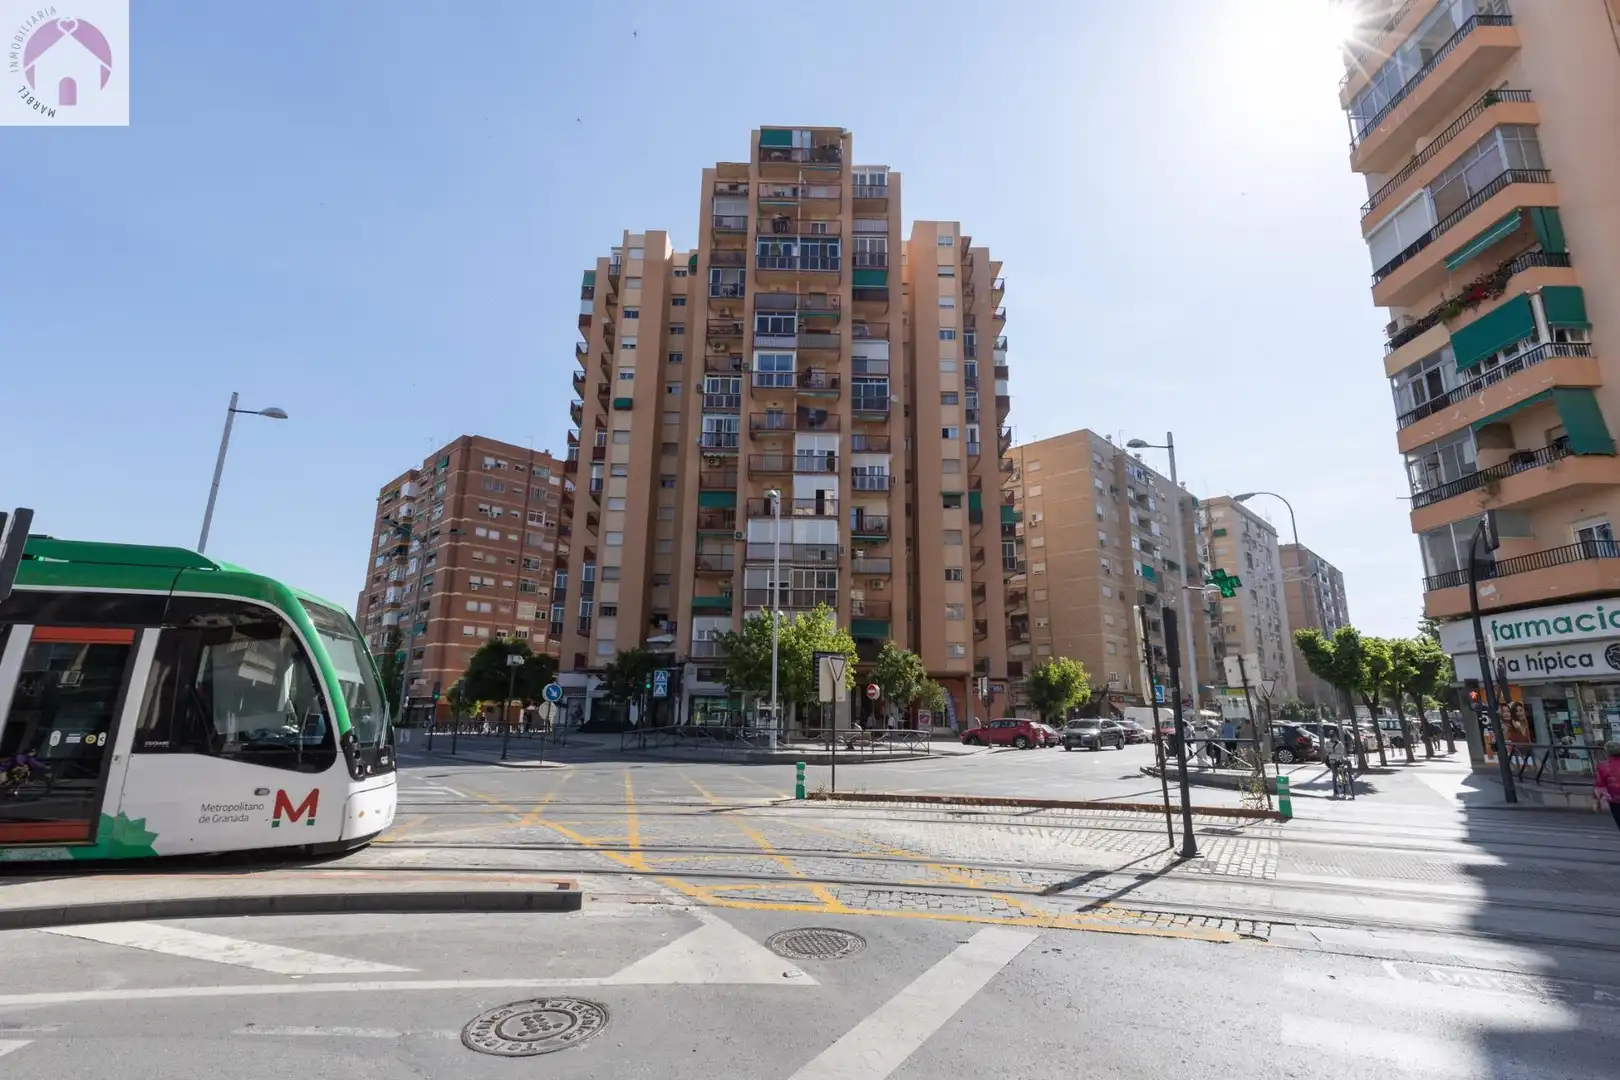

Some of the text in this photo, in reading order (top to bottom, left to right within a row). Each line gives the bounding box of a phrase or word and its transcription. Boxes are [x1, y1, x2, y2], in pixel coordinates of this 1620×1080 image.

[1525, 651, 1594, 674] hípica
[200, 802, 265, 813] Metropolitano
[272, 788, 319, 828] M
[198, 814, 249, 823] de Granada
